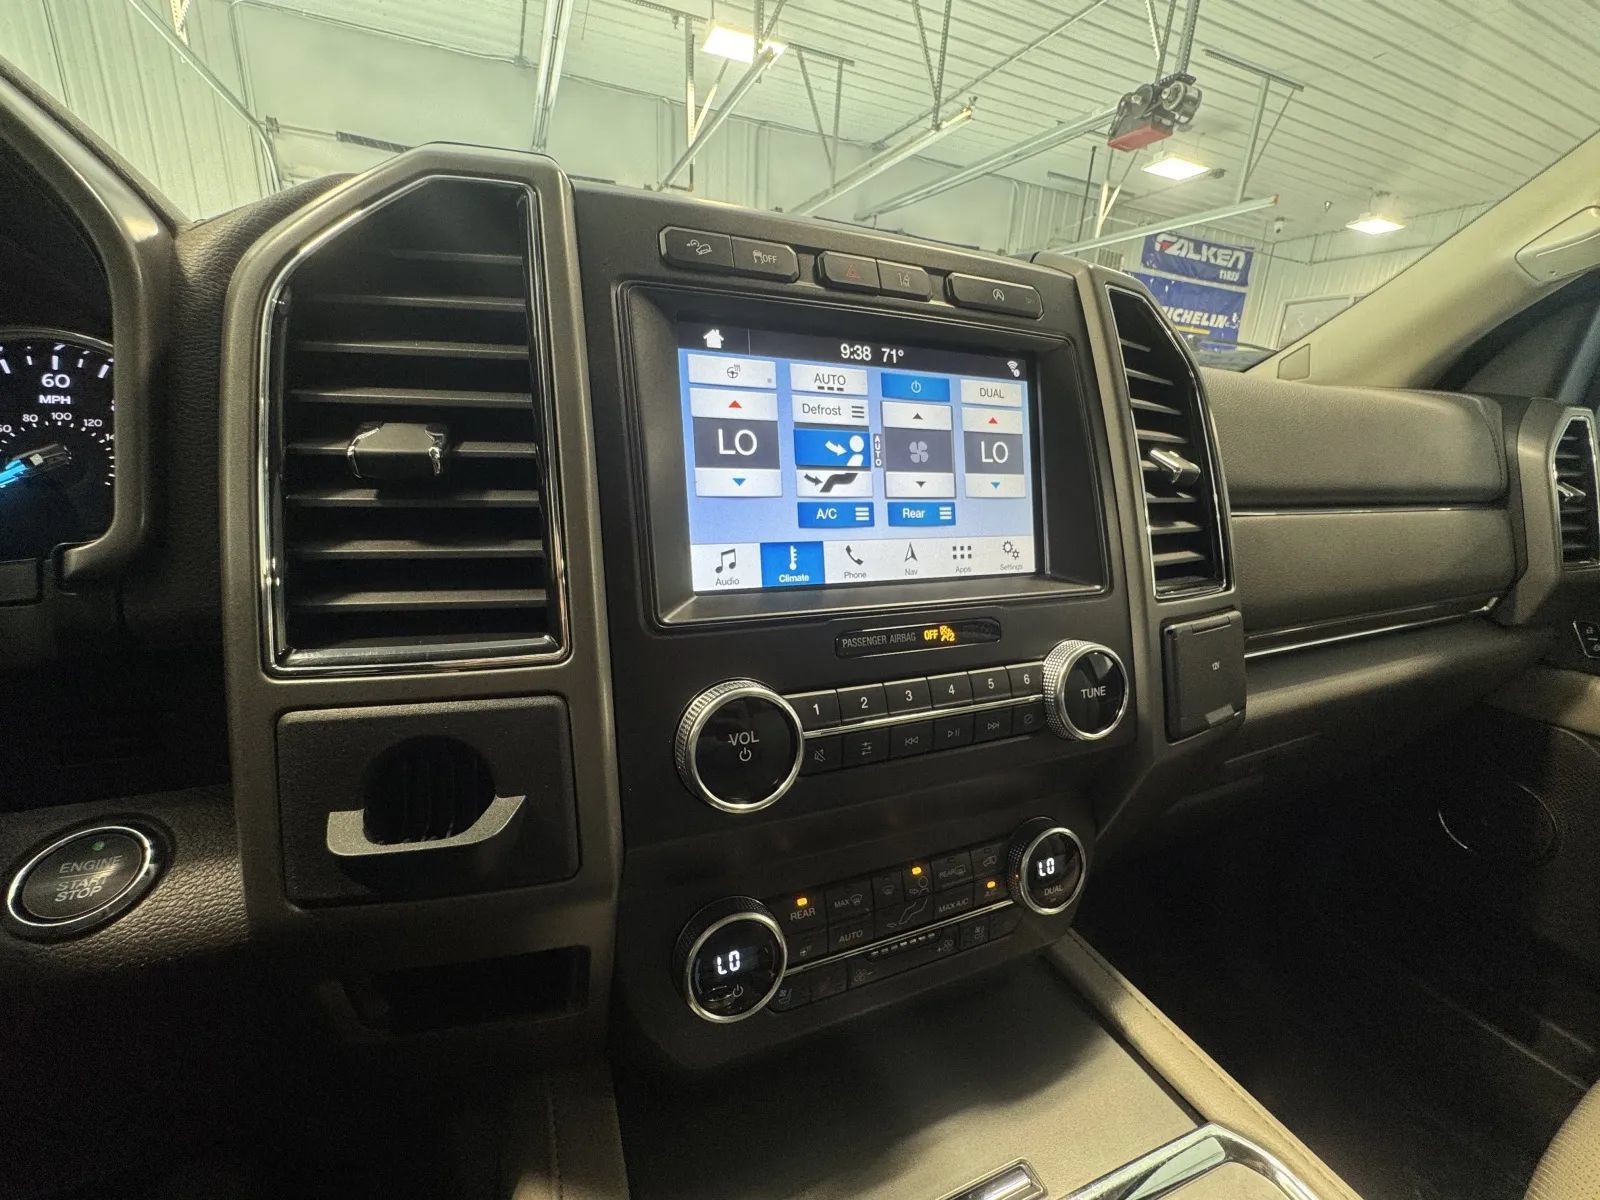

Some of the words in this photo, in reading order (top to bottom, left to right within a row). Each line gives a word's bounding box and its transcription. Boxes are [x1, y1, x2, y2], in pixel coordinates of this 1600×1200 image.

[1156, 234, 1245, 268] FALKEN
[763, 255, 777, 263] OFF
[840, 343, 872, 361] 9:38
[881, 346, 904, 364] 71°
[41, 373, 71, 388] 60
[813, 373, 847, 386] AUTO
[39, 395, 71, 404] MPH
[978, 387, 1005, 400] DUAL
[801, 403, 842, 416] Defrost
[22, 414, 39, 423] 80
[51, 412, 73, 421] 100
[83, 418, 103, 427] 120
[717, 428, 758, 456] LO
[874, 435, 882, 467] AUTO
[980, 441, 1009, 463] LO
[815, 508, 838, 520] A/C
[902, 508, 925, 520] Rear
[904, 568, 918, 577] Nav
[954, 565, 972, 575] Apps
[999, 562, 1023, 572] Settings
[715, 576, 741, 587] Audio
[778, 573, 810, 583] Climate
[843, 570, 867, 580] Phone
[842, 635, 888, 649] PASSENGER
[889, 631, 916, 645] AIRBAG
[923, 629, 939, 641] OFF
[812, 702, 819, 716] 1
[860, 696, 868, 709] 2
[905, 689, 913, 702] 3
[947, 683, 956, 696] 4
[987, 677, 995, 690] 5
[1023, 673, 1031, 686] 6
[1080, 685, 1107, 699] TUNE
[728, 730, 760, 746] VOL
[59, 855, 122, 874] ENGINE
[55, 876, 108, 892] START
[1044, 884, 1063, 896] DUAL
[54, 886, 103, 902] STOP
[833, 897, 850, 909] MAX
[938, 900, 955, 913] MAX
[789, 906, 817, 921] REAR
[838, 929, 864, 943] AUTO
